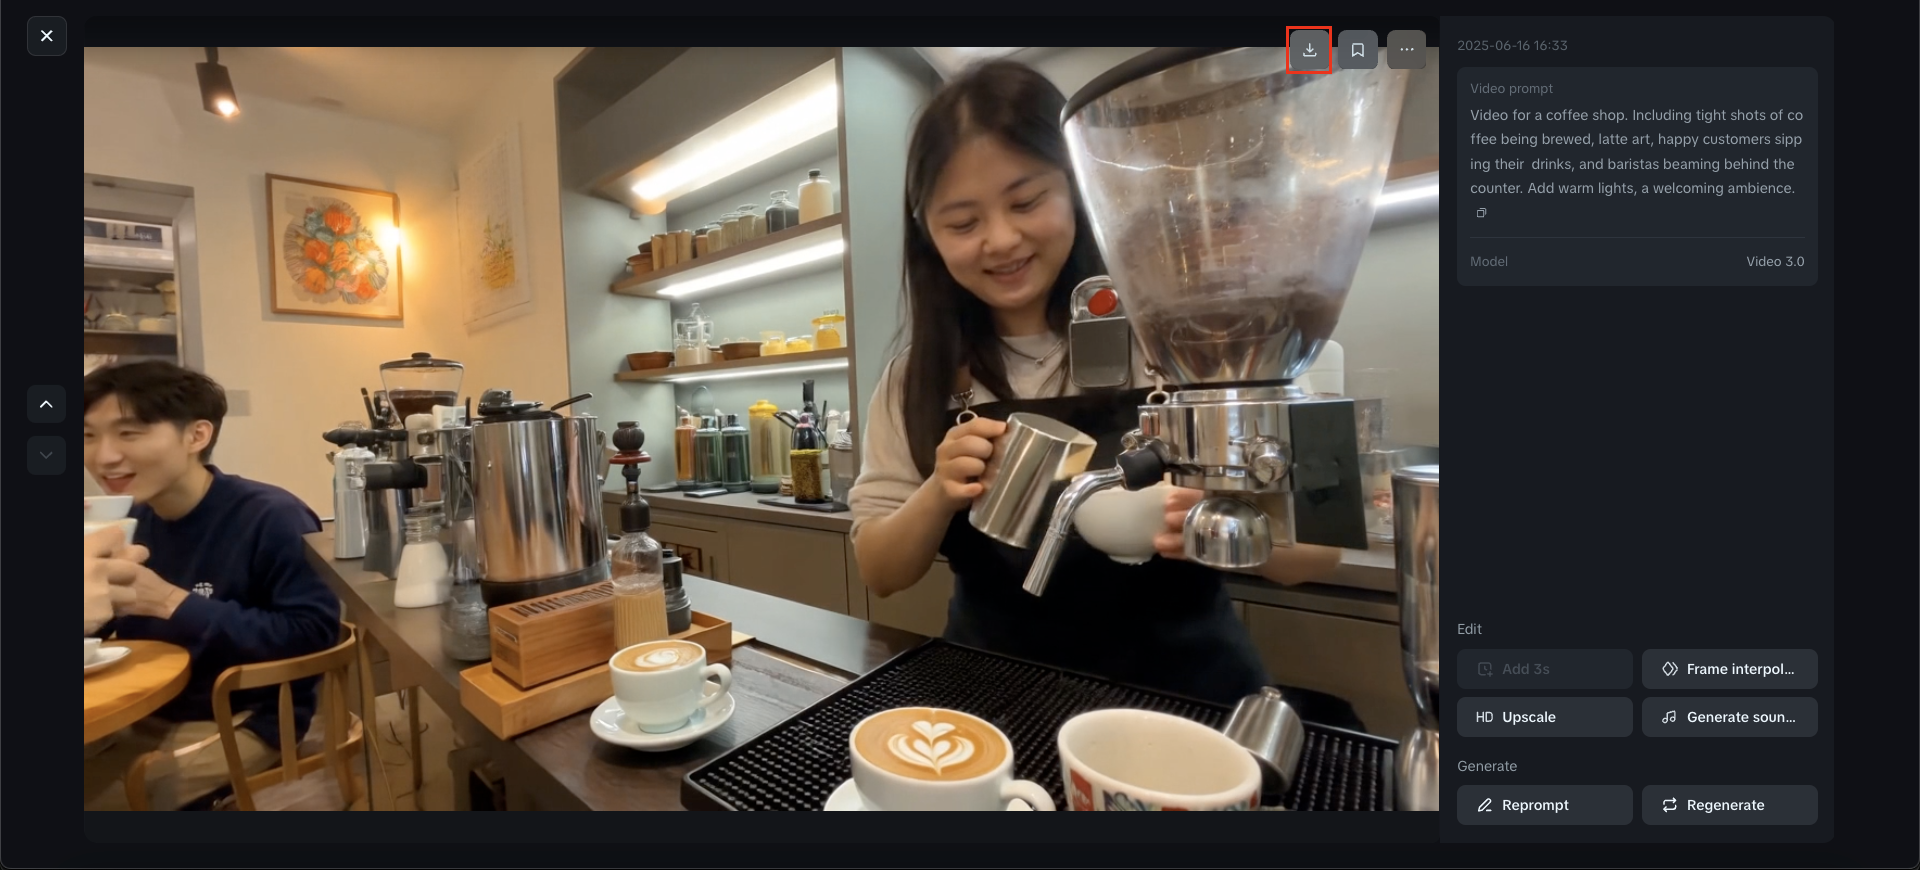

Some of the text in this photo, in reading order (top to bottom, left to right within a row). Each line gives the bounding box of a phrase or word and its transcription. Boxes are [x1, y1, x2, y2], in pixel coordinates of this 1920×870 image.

[1457, 39, 1568, 51] 2025-06-16 16:33
[1470, 82, 1554, 97] Video prompt
[1470, 108, 1804, 124] Video for a coffee shop. Including tight shots of co
[1470, 132, 1803, 148] ffee being brewed, latte art, happy customers sipp
[1470, 157, 1795, 173] ing their drinks, and baristas beaming behind the
[1470, 181, 1795, 197] counter. Add warm lights, a welcoming ambience.
[1470, 255, 1508, 267] Model
[1746, 255, 1805, 267] Video 3.0
[1457, 622, 1483, 635] Edit
[1501, 662, 1550, 675] Add 3s
[1687, 663, 1729, 675] Frame
[1475, 710, 1494, 723] HD
[1502, 710, 1557, 726] Upscale
[1687, 710, 1750, 723] Generate
[1457, 759, 1518, 772] Generate
[1502, 799, 1570, 814] Reprompt
[1687, 799, 1765, 814] Regenerate
